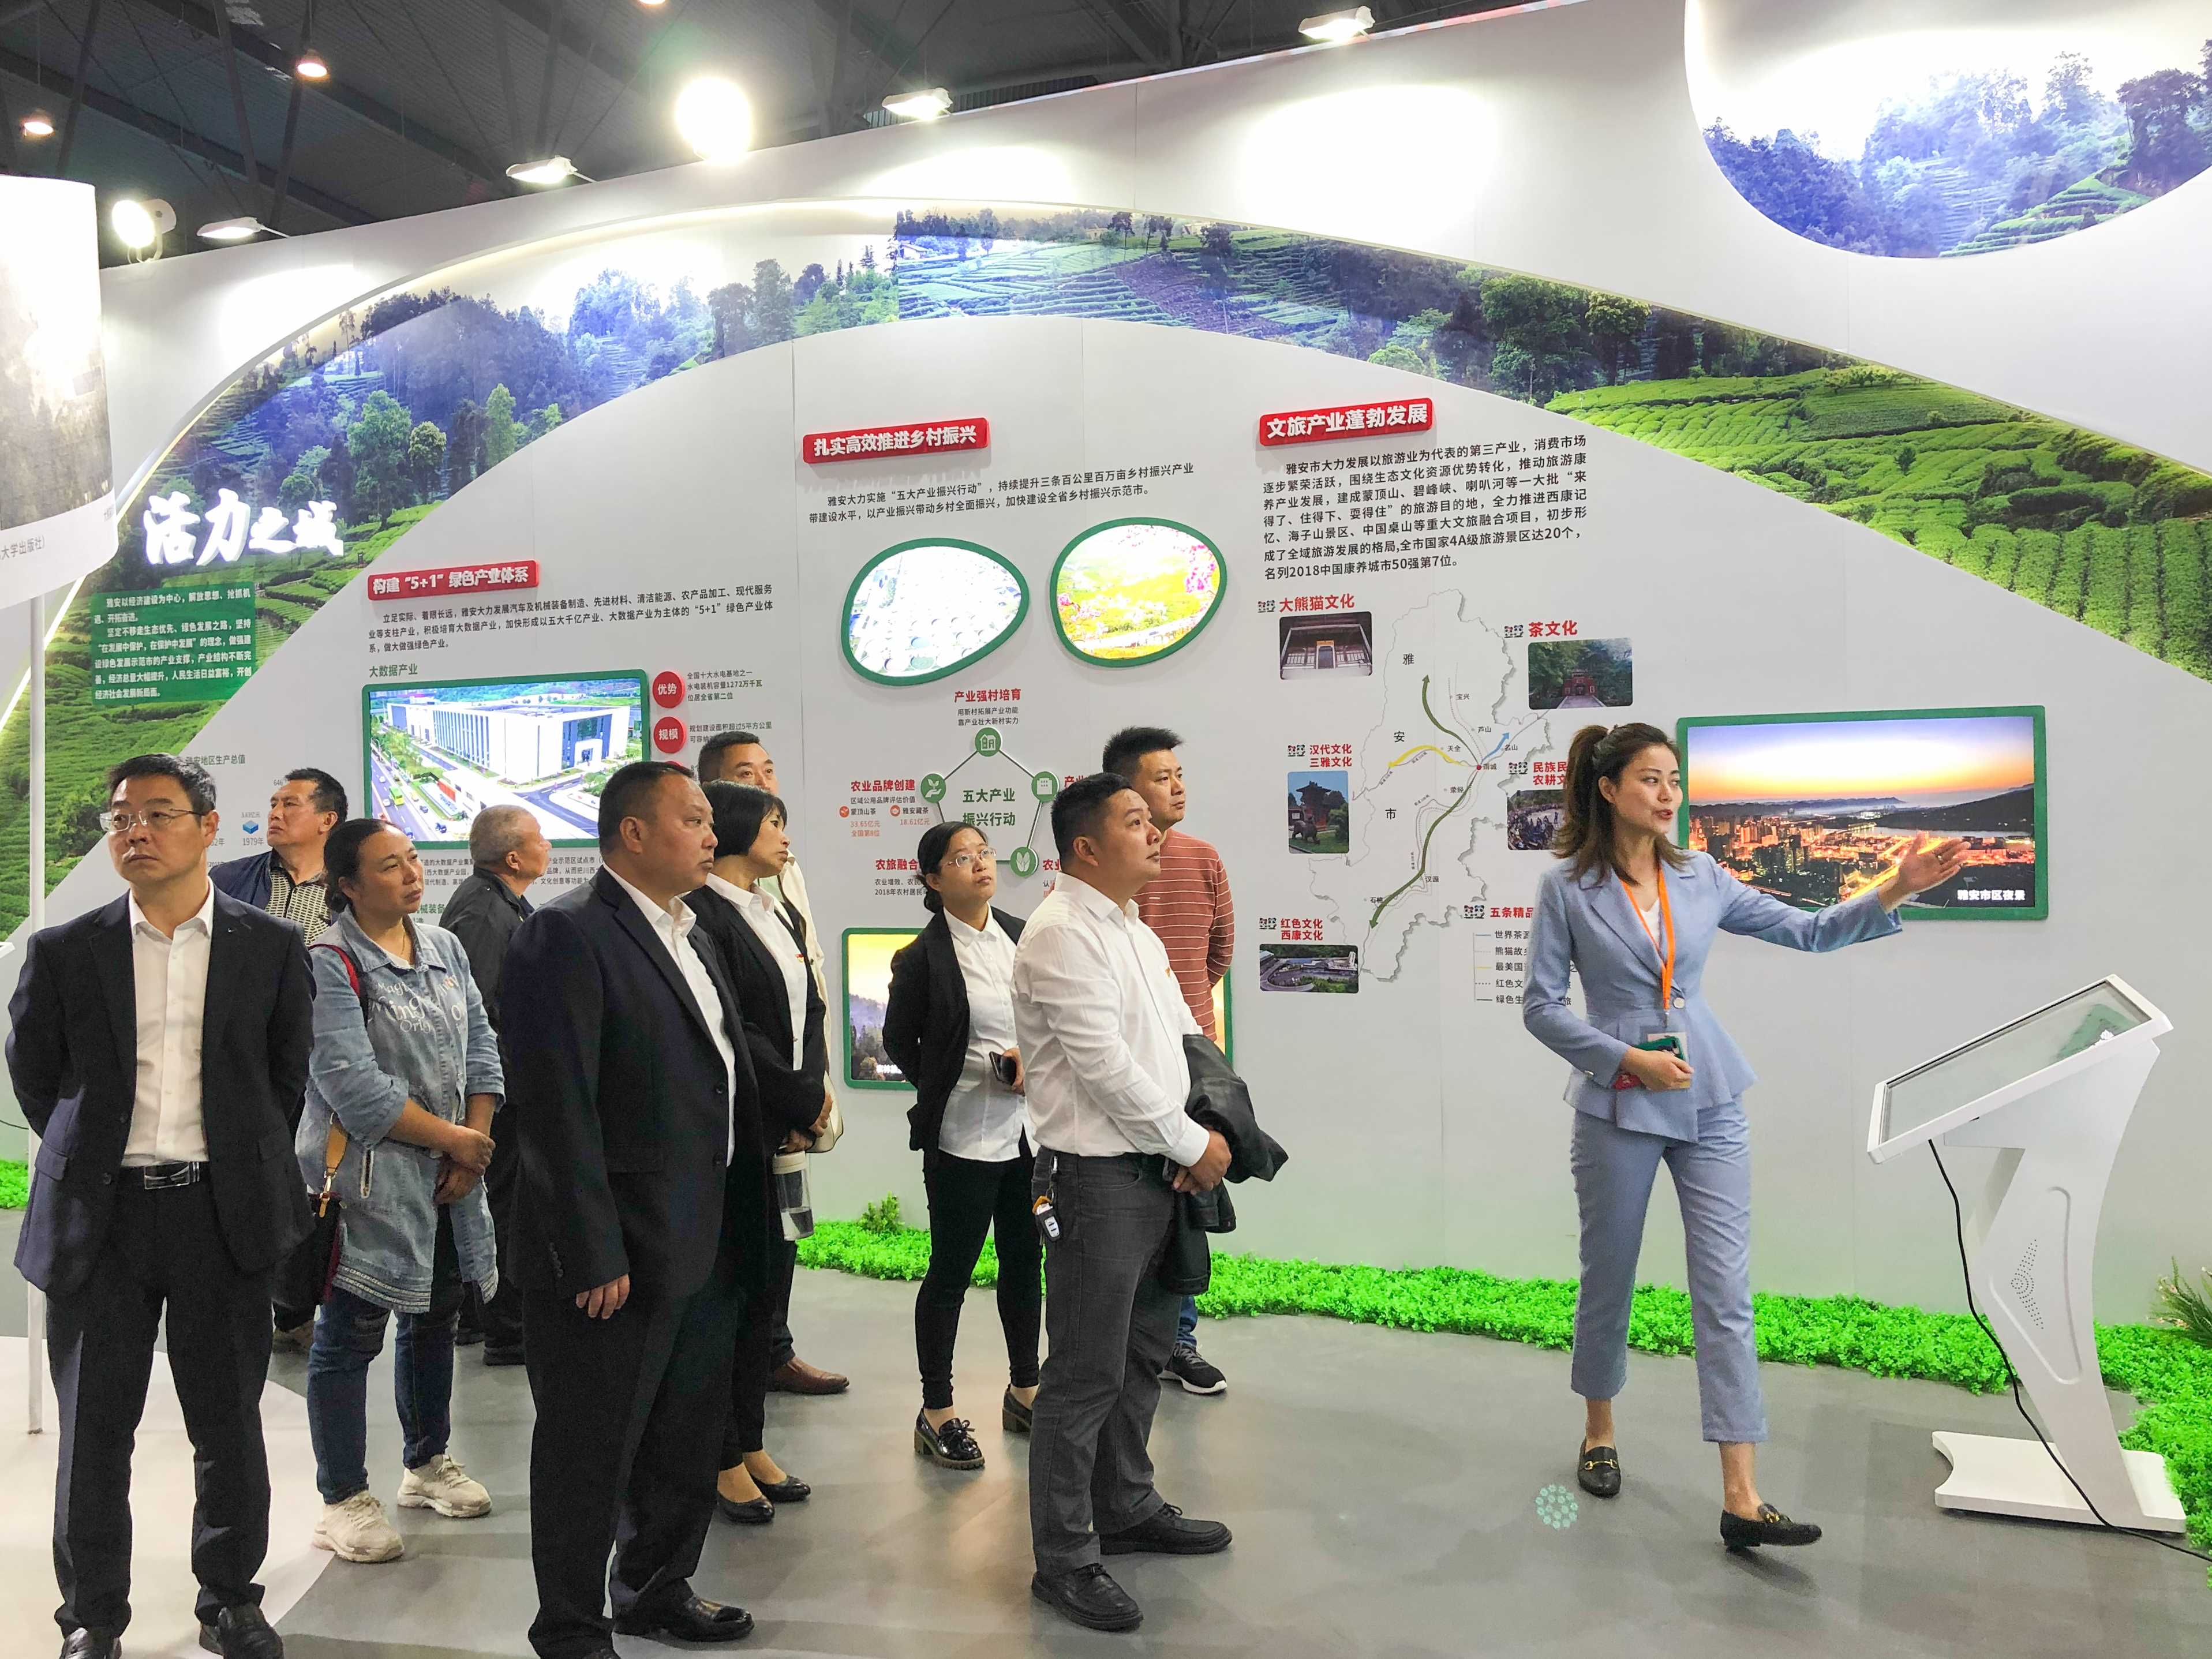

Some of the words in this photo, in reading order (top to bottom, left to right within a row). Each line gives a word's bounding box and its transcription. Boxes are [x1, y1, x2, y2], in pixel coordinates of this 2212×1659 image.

[1267, 404, 1428, 439] 文旅产业蓬勃发展
[814, 425, 976, 456] 扎实高效推进乡村振兴
[1286, 435, 1586, 475] 雅安市大力发展以旅游业为代表的第三产业，消费市场
[1263, 452, 1586, 494] 逐步繁荣活跃，围绕生态文化资源优势转化，推动旅游康
[809, 484, 1149, 523] 带建设水平，以产业振兴带动乡村全面振兴，加快建设全省乡村振兴示范市。
[144, 488, 343, 566] 活力之城
[1264, 506, 1586, 544] 忆、海子山景区、中国桌山等重大文旅融合项目，初步形
[0, 535, 45, 560] 大学出版社)
[1264, 555, 1458, 581] 名列2018中国康养城市50强第7位。
[1279, 593, 1355, 613] 大熊猫文化
[1528, 620, 1578, 637] 茶文化
[369, 639, 448, 653] 系，做大做强绿色产业。
[1402, 653, 1414, 665] 雅
[369, 664, 417, 678] 大数据产业
[687, 669, 753, 680] 全国十大水电基地之一
[657, 683, 677, 695] 优势
[687, 679, 762, 691] 水电装机容量1272万千瓦
[687, 692, 733, 702] 位居全省第二位
[954, 687, 1021, 703] 产业强村培育
[958, 706, 1019, 716] 用新村拓展产业功能
[690, 721, 772, 732] 规划建设面积超过5平方公里
[958, 717, 1019, 726] 靠产业壮大新村实力
[658, 728, 679, 741] 规模
[690, 735, 709, 744] 可容纳
[1394, 731, 1405, 743] 安
[1309, 744, 1352, 755] 汉代文化
[1309, 757, 1352, 767] 三雅文化
[851, 779, 916, 792] 农业品牌创建
[850, 796, 916, 804] 区域公用品牌评估价值
[963, 788, 1015, 803] 五大产业
[963, 812, 1016, 826] 振兴行动
[1385, 808, 1397, 820] 市
[242, 837, 264, 846] 1979年
[875, 858, 918, 870] 农旅融合
[875, 878, 922, 886] 农业增效、农民
[1957, 889, 2025, 901] 雅安市区夜景
[417, 904, 444, 914] 械装备
[1490, 907, 1533, 919] 五条精品
[1281, 918, 1323, 929] 红色文化
[1281, 930, 1323, 941] 西康文化
[1495, 963, 1526, 971] 最美国
